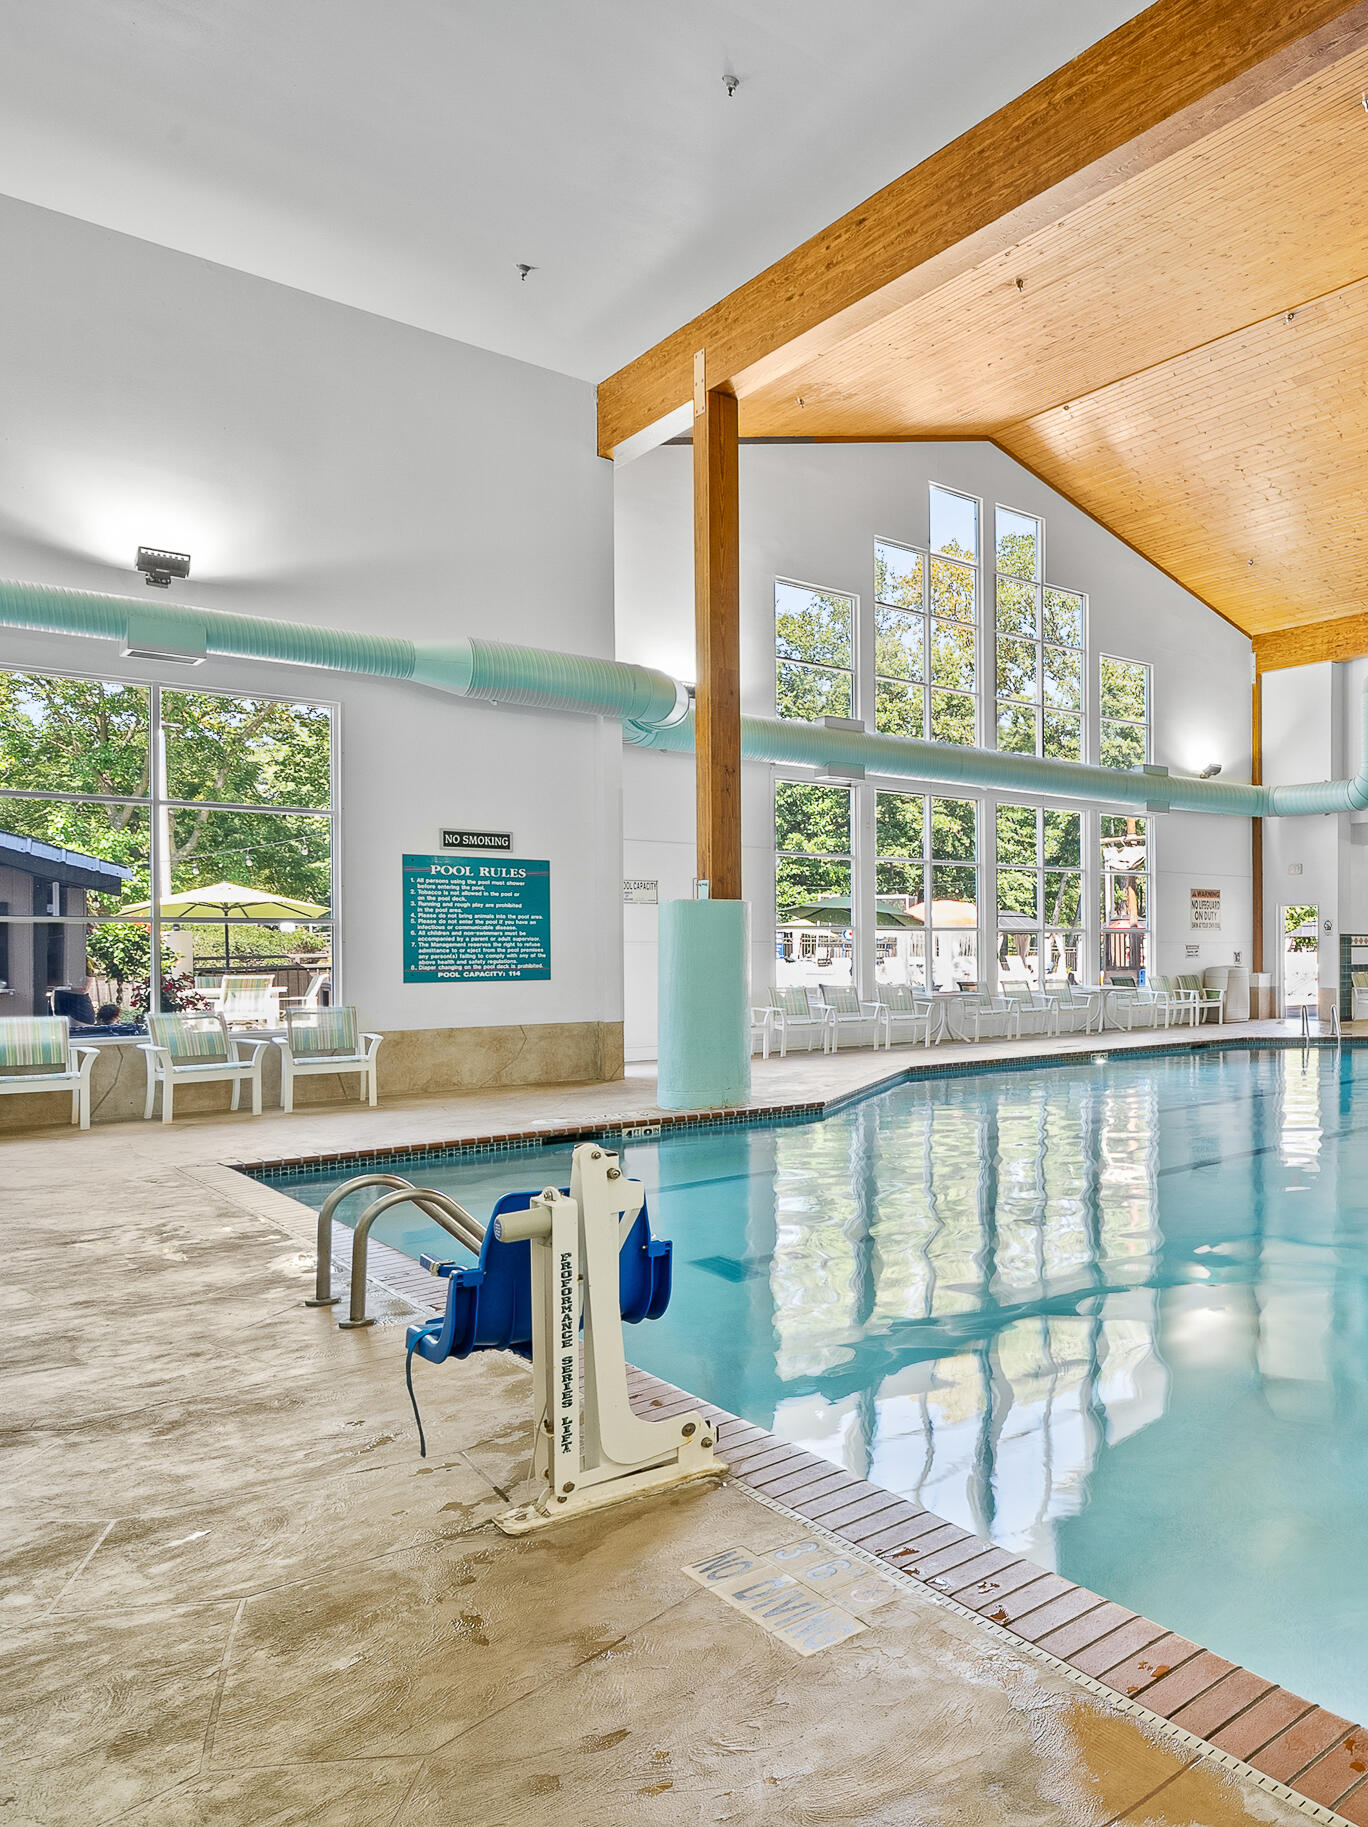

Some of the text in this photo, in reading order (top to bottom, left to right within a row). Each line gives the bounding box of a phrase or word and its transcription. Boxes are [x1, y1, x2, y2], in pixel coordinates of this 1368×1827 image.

[445, 834, 509, 847] NO SMOKING
[430, 864, 526, 878] POOL RULES
[560, 1252, 573, 1348] PROFORMANCE
[561, 1356, 573, 1408] SERIES
[774, 1541, 820, 1561] 3
[805, 1559, 852, 1581] 6
[692, 1551, 856, 1650] NO DIVING
